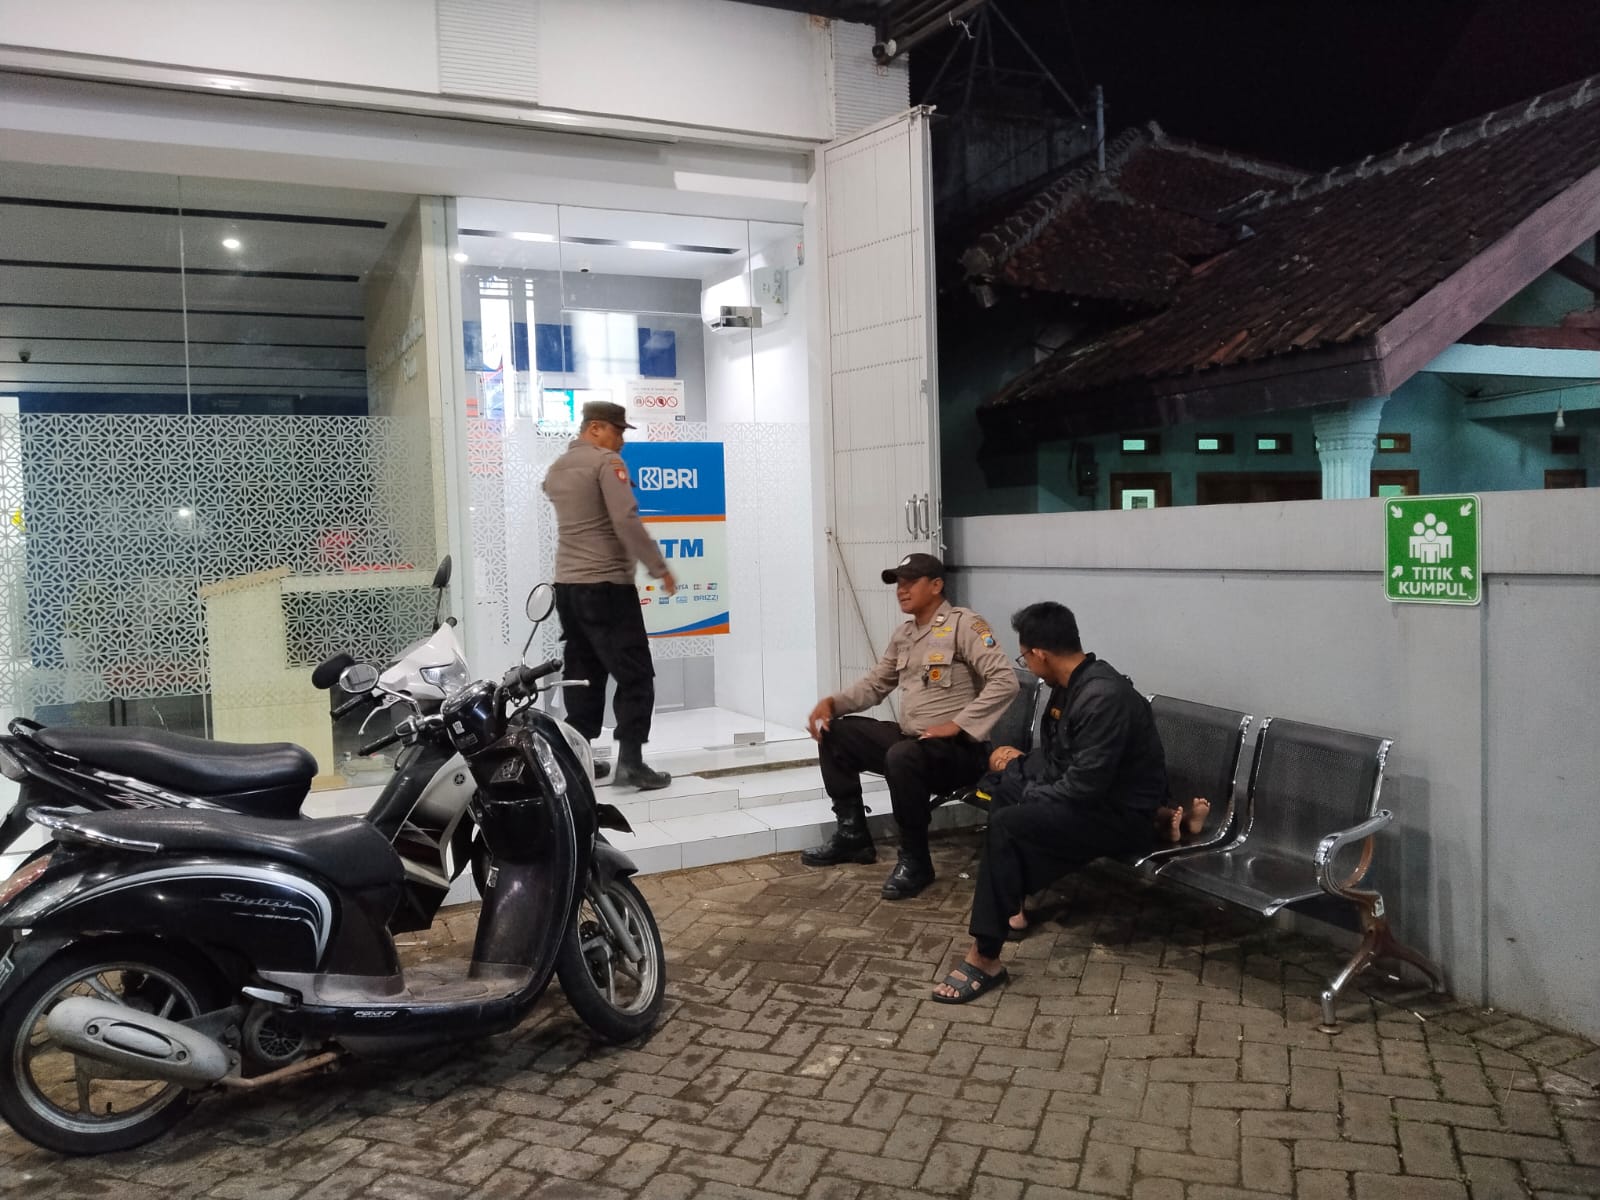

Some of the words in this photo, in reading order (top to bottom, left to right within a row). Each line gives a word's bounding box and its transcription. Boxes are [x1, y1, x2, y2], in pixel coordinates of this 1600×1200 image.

[663, 468, 697, 488] BRI
[656, 538, 703, 558] TM
[1412, 567, 1454, 580] TITIK
[1398, 582, 1467, 595] KUMPUL
